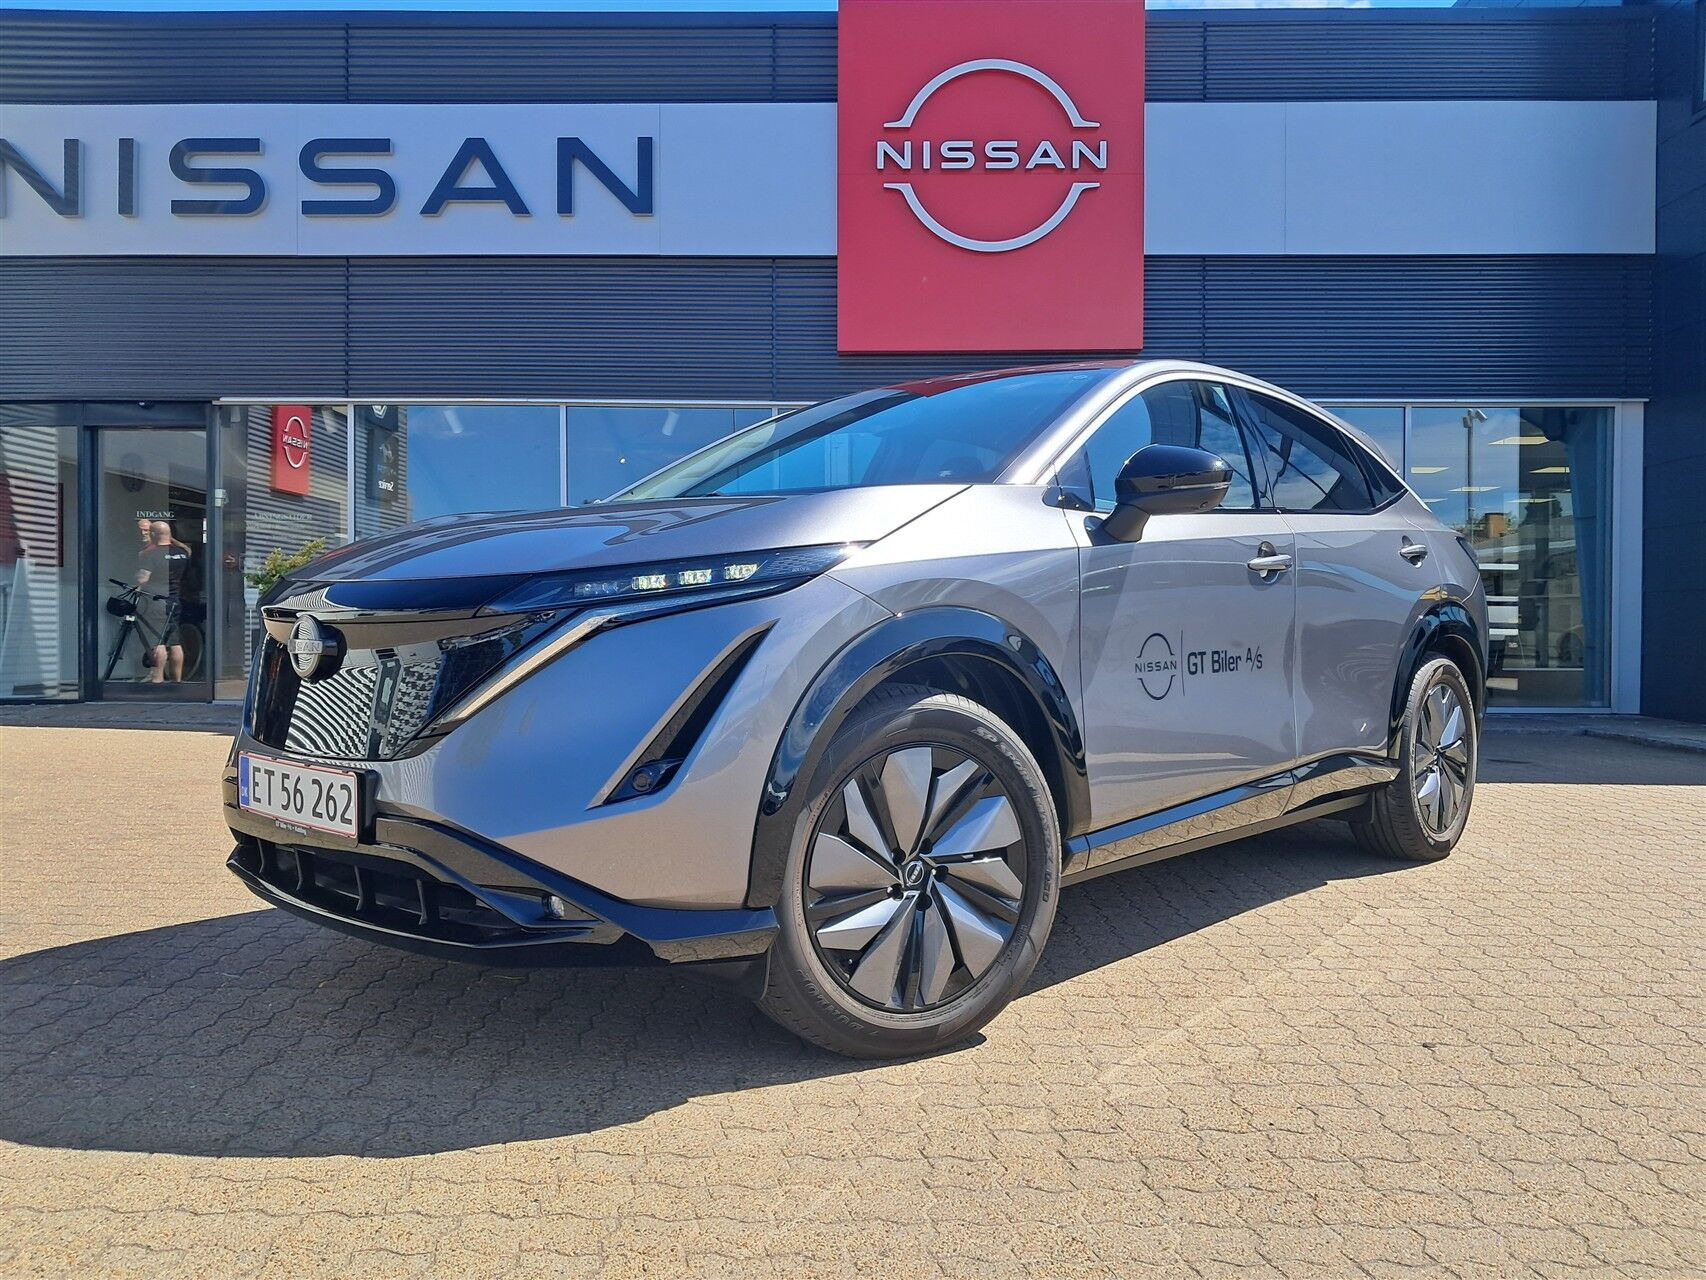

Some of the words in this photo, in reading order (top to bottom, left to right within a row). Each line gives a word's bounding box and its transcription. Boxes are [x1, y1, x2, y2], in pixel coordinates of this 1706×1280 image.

[876, 140, 1108, 170] NISSAN
[0, 137, 655, 217] NISSAN
[136, 510, 175, 519] INDGANG
[1135, 661, 1176, 673] NISSAN
[1187, 652, 1206, 675] GT
[1211, 650, 1242, 674] Biler
[252, 765, 275, 807] ET
[281, 772, 304, 815] 56
[311, 778, 353, 826] 262
